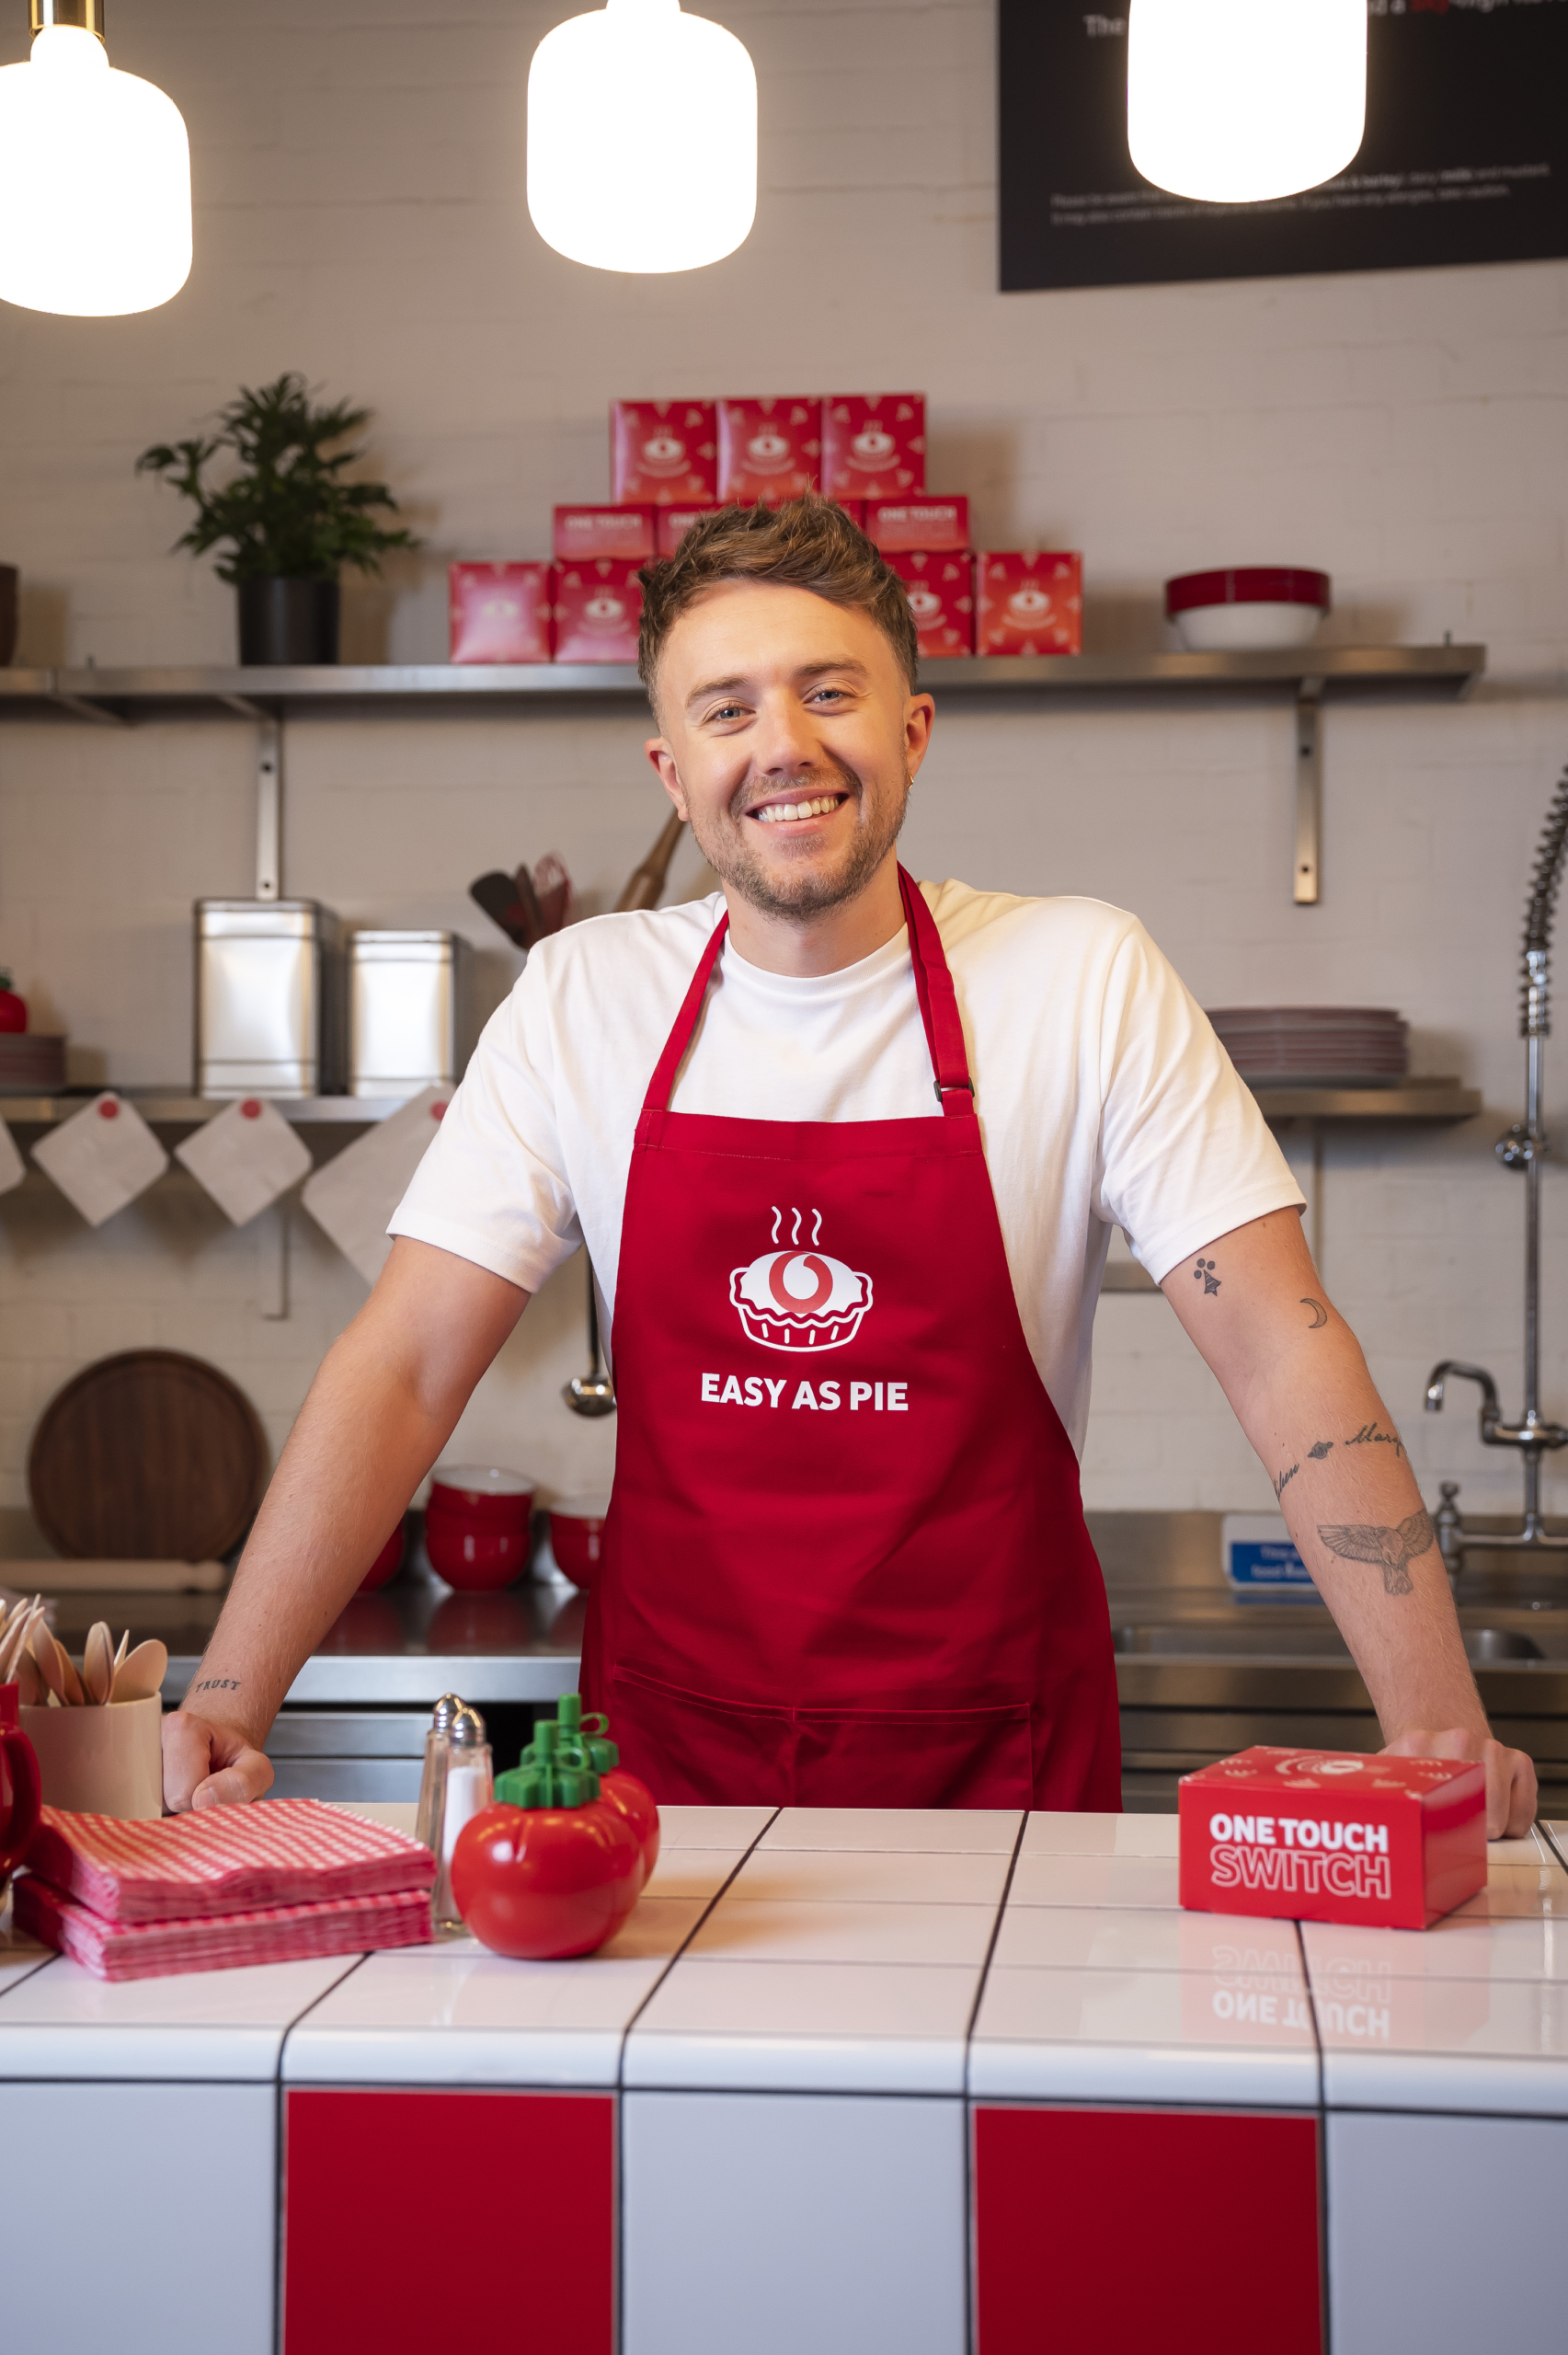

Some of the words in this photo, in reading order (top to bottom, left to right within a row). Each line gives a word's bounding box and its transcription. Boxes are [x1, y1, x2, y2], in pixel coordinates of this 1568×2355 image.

[701, 1373, 787, 1408] EASY
[791, 1381, 841, 1411] AS
[850, 1382, 909, 1411] PIE
[195, 1679, 242, 1694] TRUST
[1209, 1813, 1276, 1845] ONE
[1277, 1818, 1389, 1854] TOUCH
[1209, 1844, 1391, 1900] SWITCH
